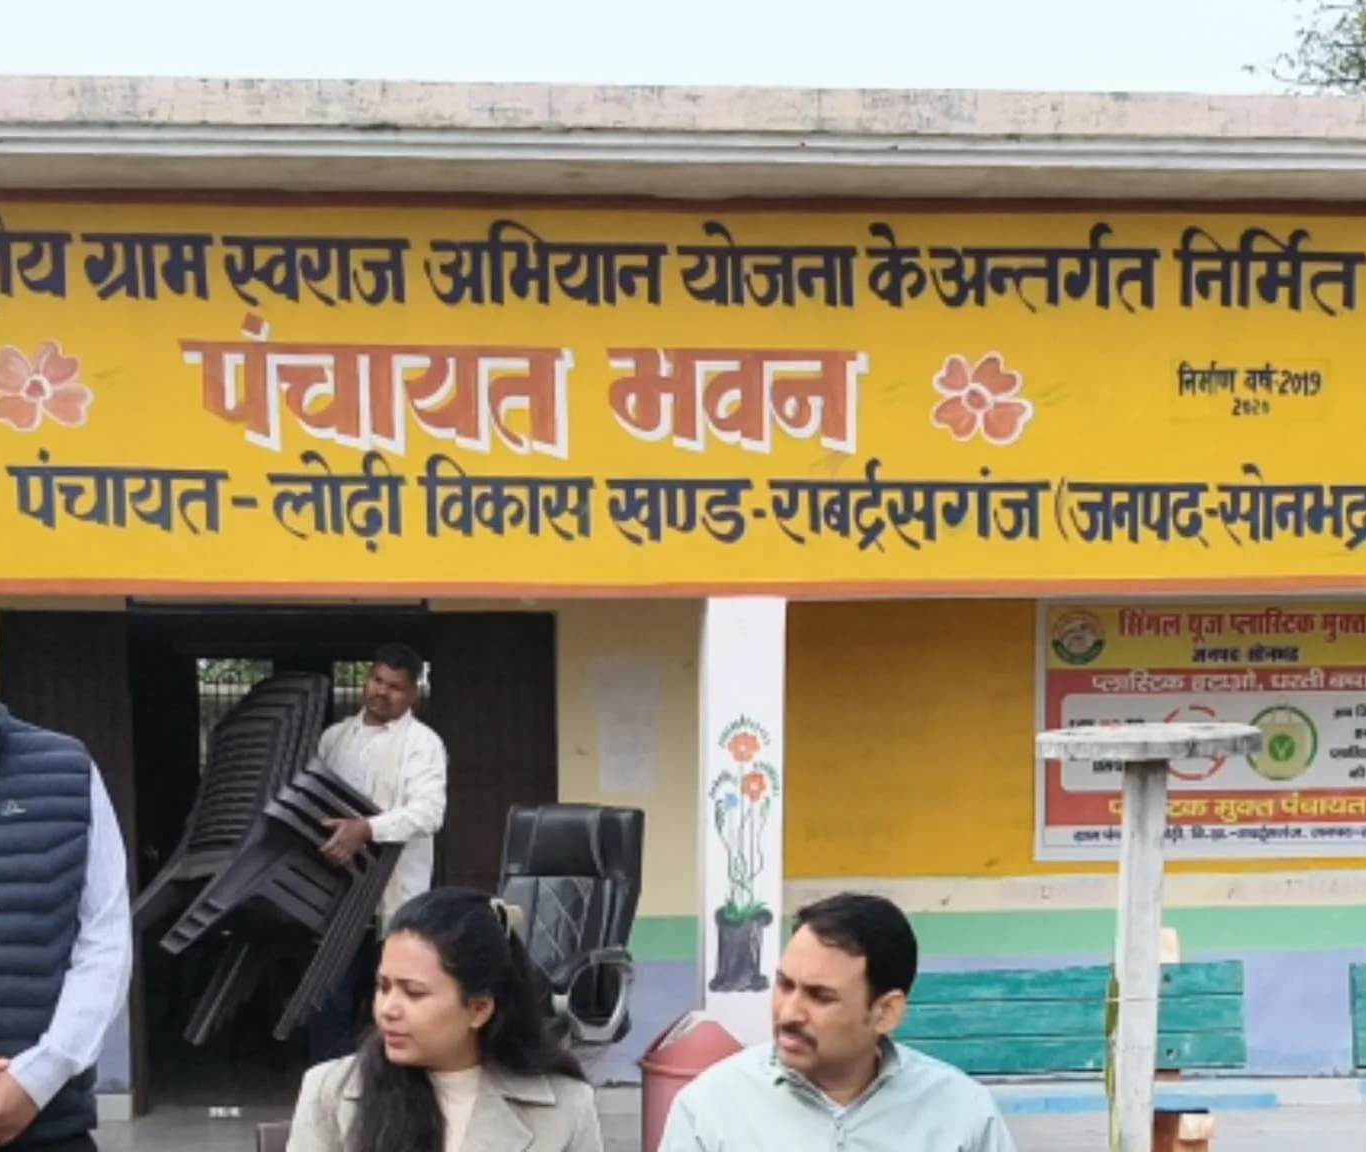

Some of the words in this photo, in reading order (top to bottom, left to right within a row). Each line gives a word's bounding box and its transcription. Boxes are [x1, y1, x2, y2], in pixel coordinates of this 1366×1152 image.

[81, 233, 213, 301] ग्राम
[222, 236, 410, 306] स्वराज
[424, 219, 668, 306] अभियान
[678, 221, 857, 307] योजना
[180, 312, 574, 459] पंचायत
[607, 348, 869, 454] भवन
[1177, 360, 1237, 396] निर्माण
[419, 454, 594, 541] विकास
[1189, 613, 1223, 642] यूज
[1231, 607, 1317, 636] प्लास्टिक
[1091, 668, 1184, 690] प्लास्टिक
[1270, 668, 1325, 689] धरती
[1214, 799, 1275, 823] मुक्त
